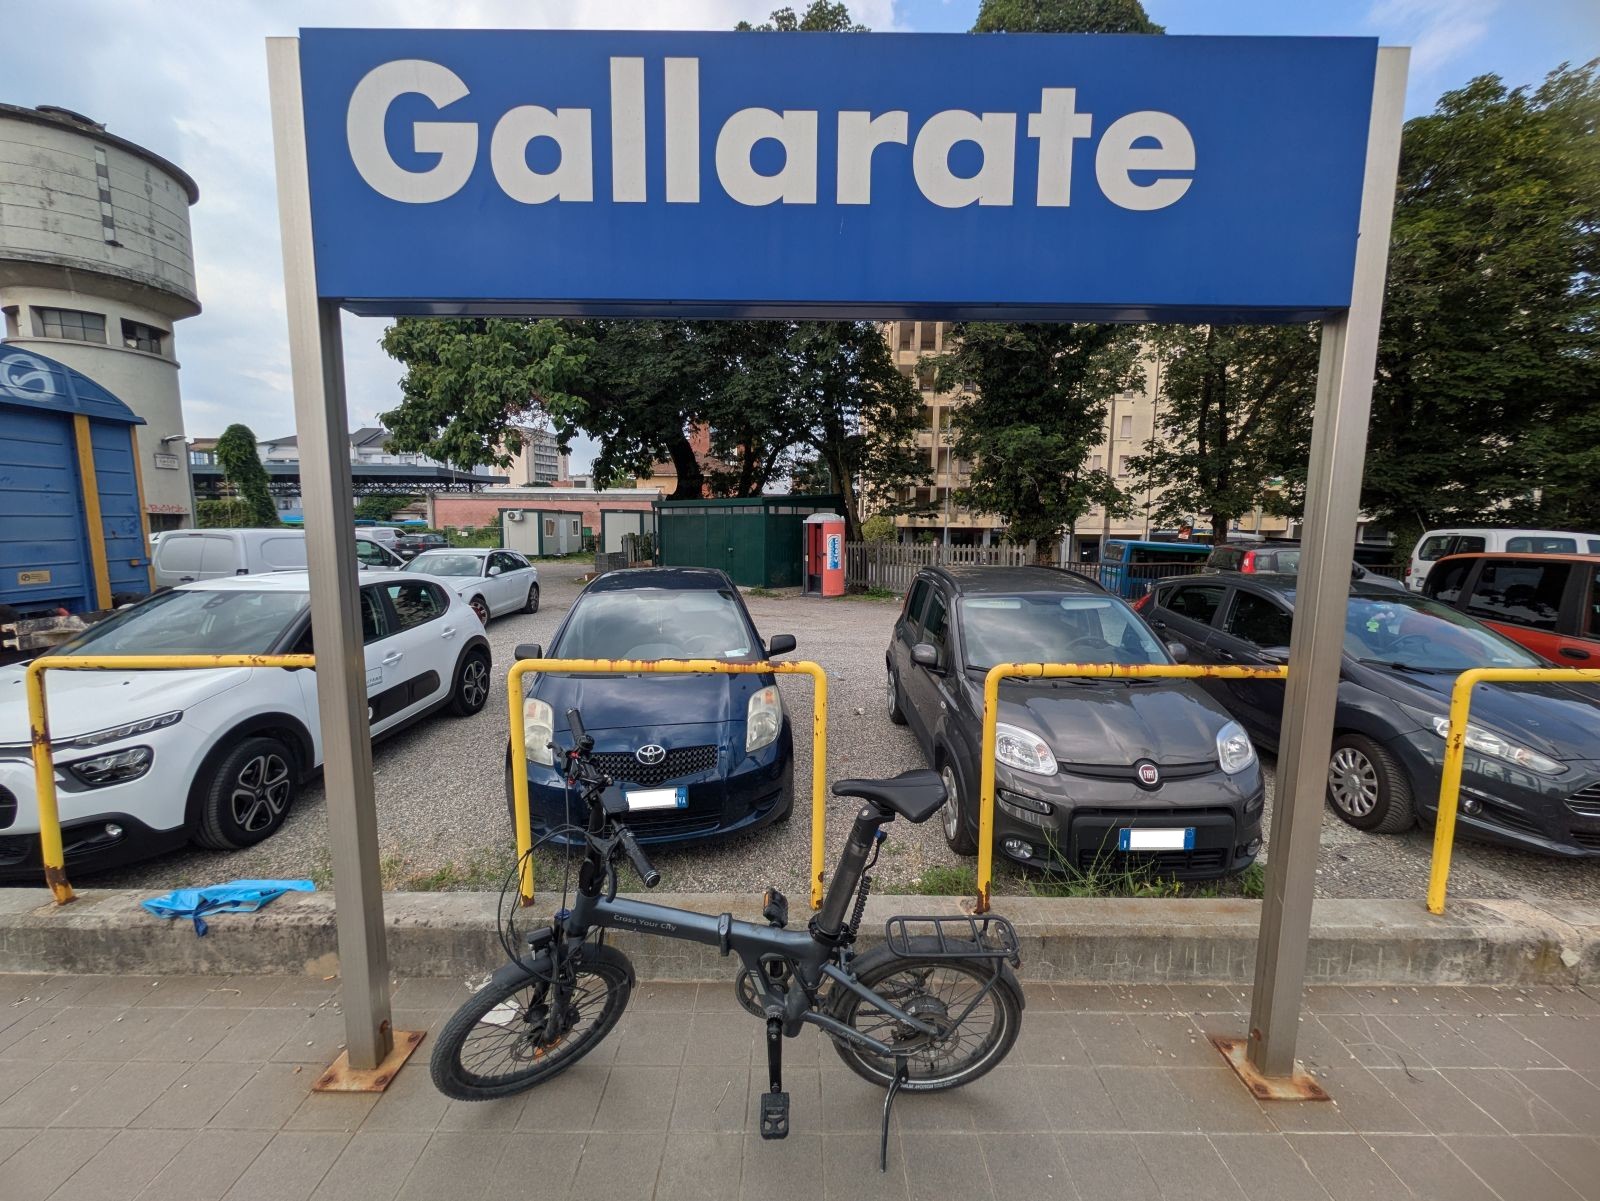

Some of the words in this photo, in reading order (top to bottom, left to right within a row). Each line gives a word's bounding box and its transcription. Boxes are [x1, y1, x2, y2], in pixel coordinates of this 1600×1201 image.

[347, 56, 1196, 210] Gallarate
[678, 796, 686, 804] VA
[613, 914, 637, 924] Cross
[639, 919, 658, 928] Your
[660, 922, 677, 932] City
